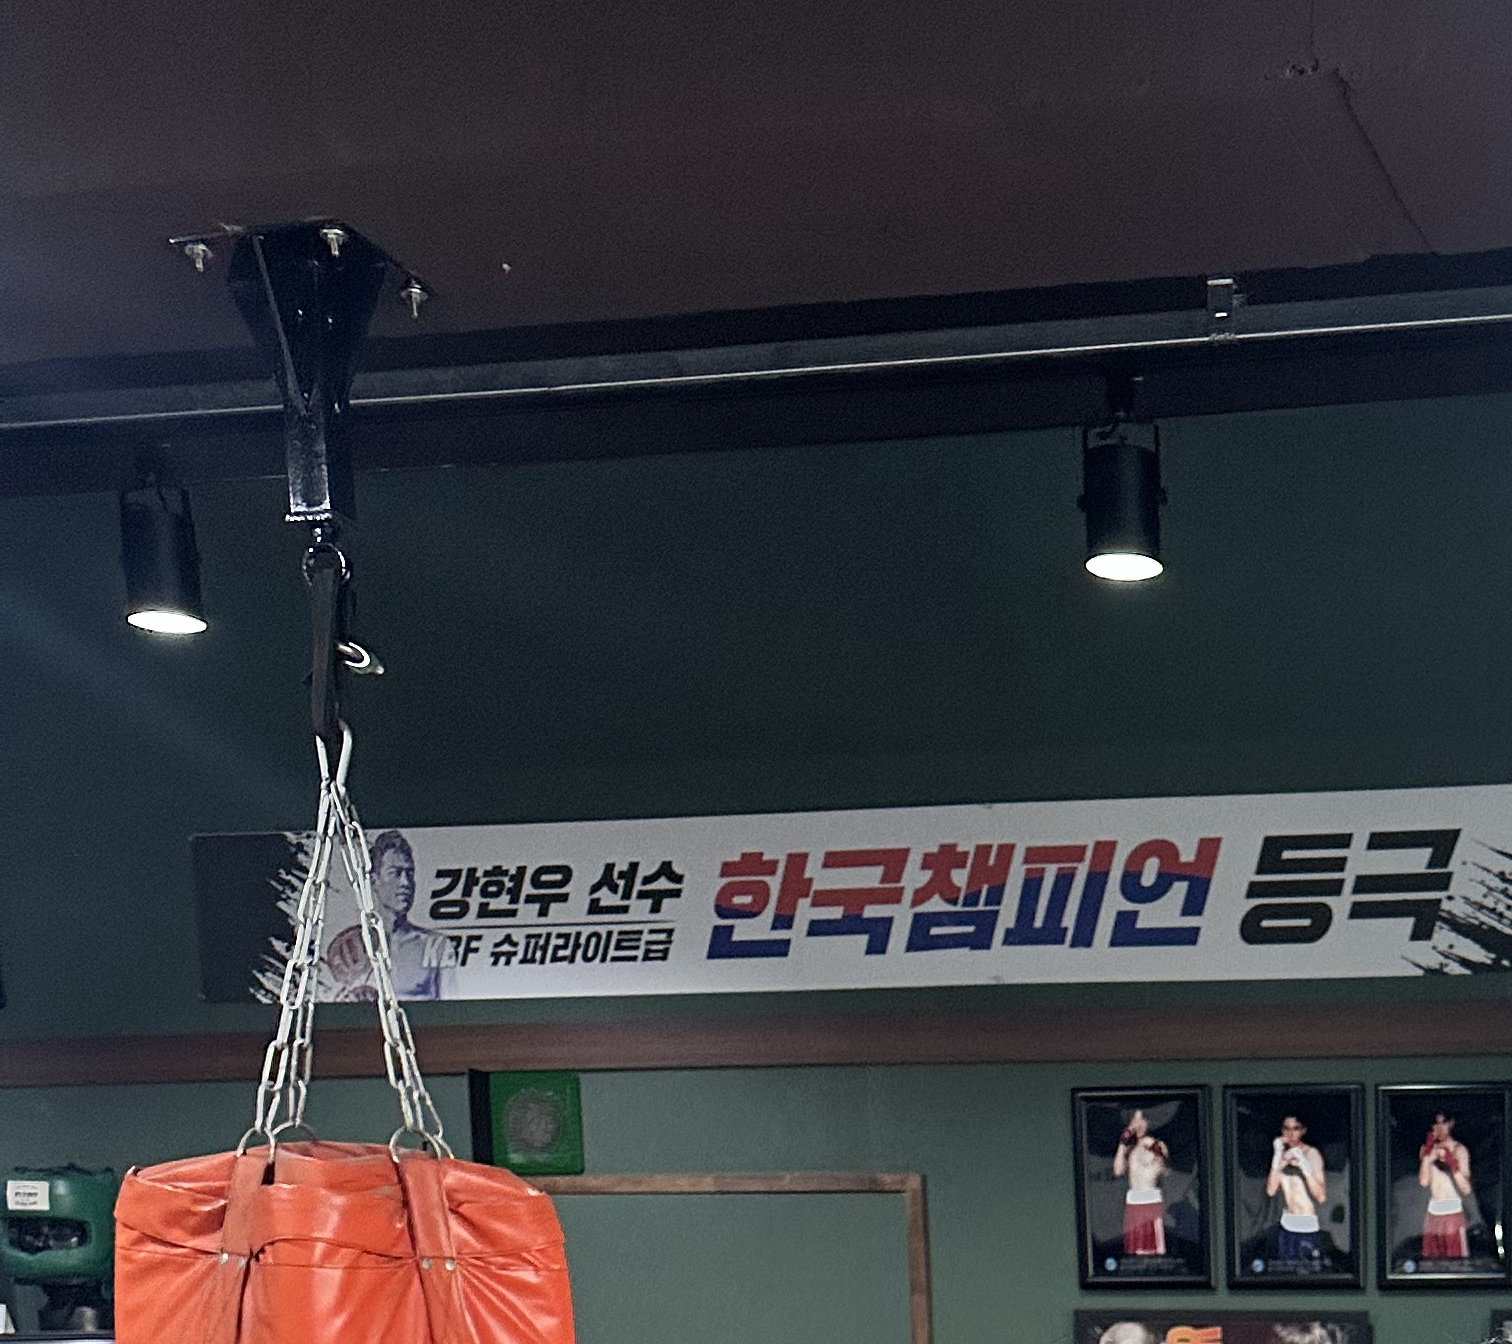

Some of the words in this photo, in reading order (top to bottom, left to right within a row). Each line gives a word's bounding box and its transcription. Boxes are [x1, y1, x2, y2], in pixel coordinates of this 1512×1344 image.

[429, 864, 573, 921] 강현우
[587, 860, 685, 916] 선수
[706, 836, 1224, 960] 한국챔피언
[1239, 828, 1462, 946] 등극
[489, 927, 676, 967] 슈퍼라이트급
